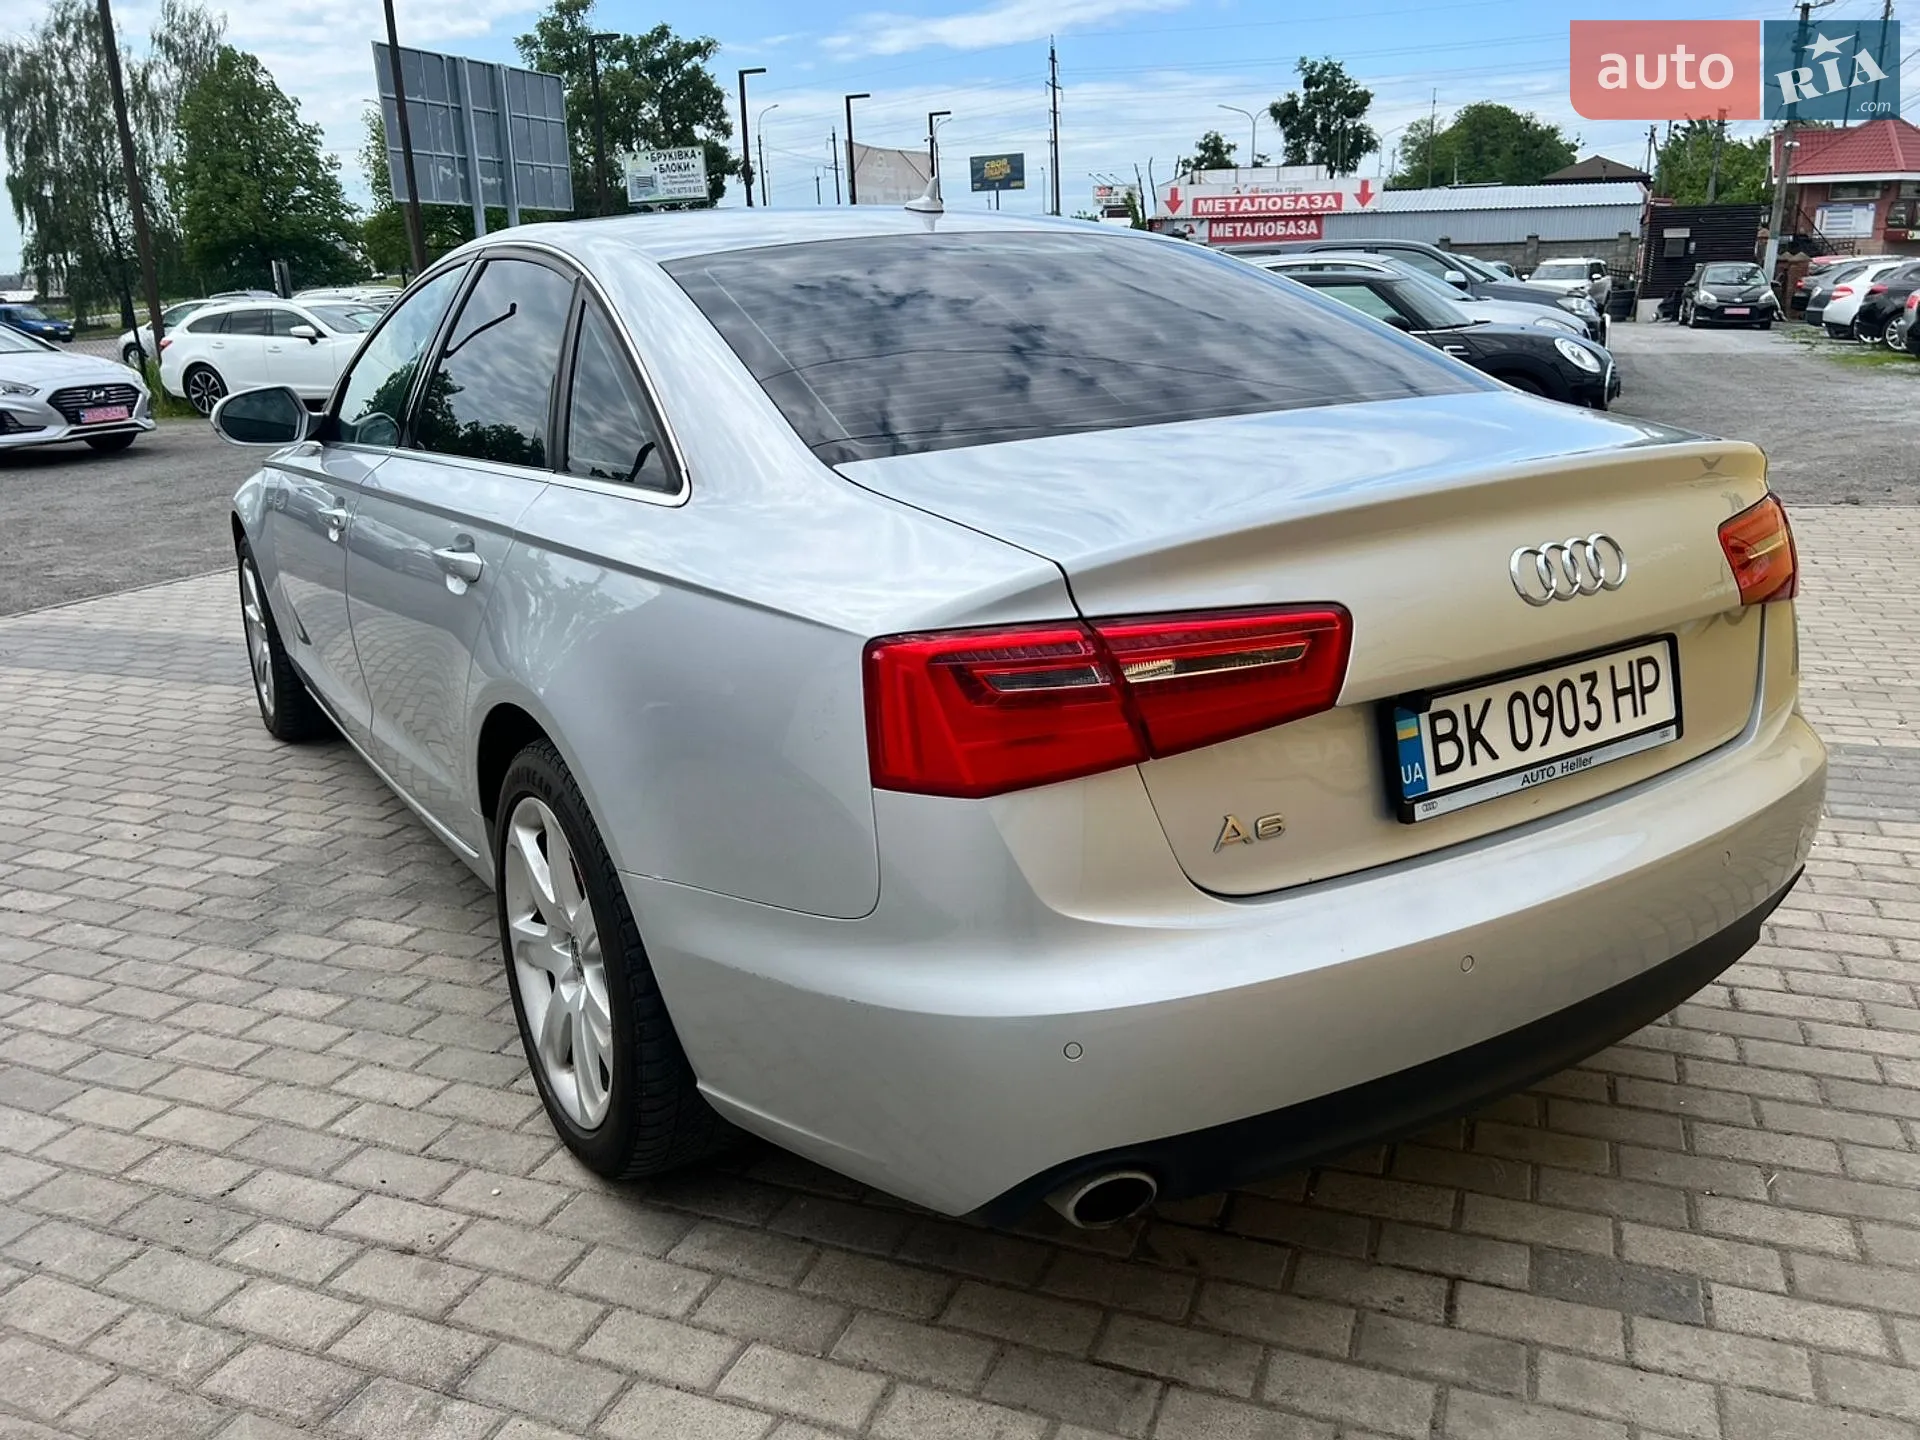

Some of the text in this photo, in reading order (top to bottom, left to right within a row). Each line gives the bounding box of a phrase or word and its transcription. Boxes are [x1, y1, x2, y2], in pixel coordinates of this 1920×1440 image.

[650, 149, 697, 162] БРУКІВКА
[658, 162, 690, 174] БЛОКИ
[1197, 195, 1337, 213] МЕТАЛОБАЗА
[1211, 220, 1318, 238] МЕТАЛОБАЗА
[1428, 655, 1660, 776] BK 0903 HP
[1401, 762, 1425, 785] UA
[1521, 755, 1593, 787] AUTO Heller
[1212, 813, 1286, 854] A6
